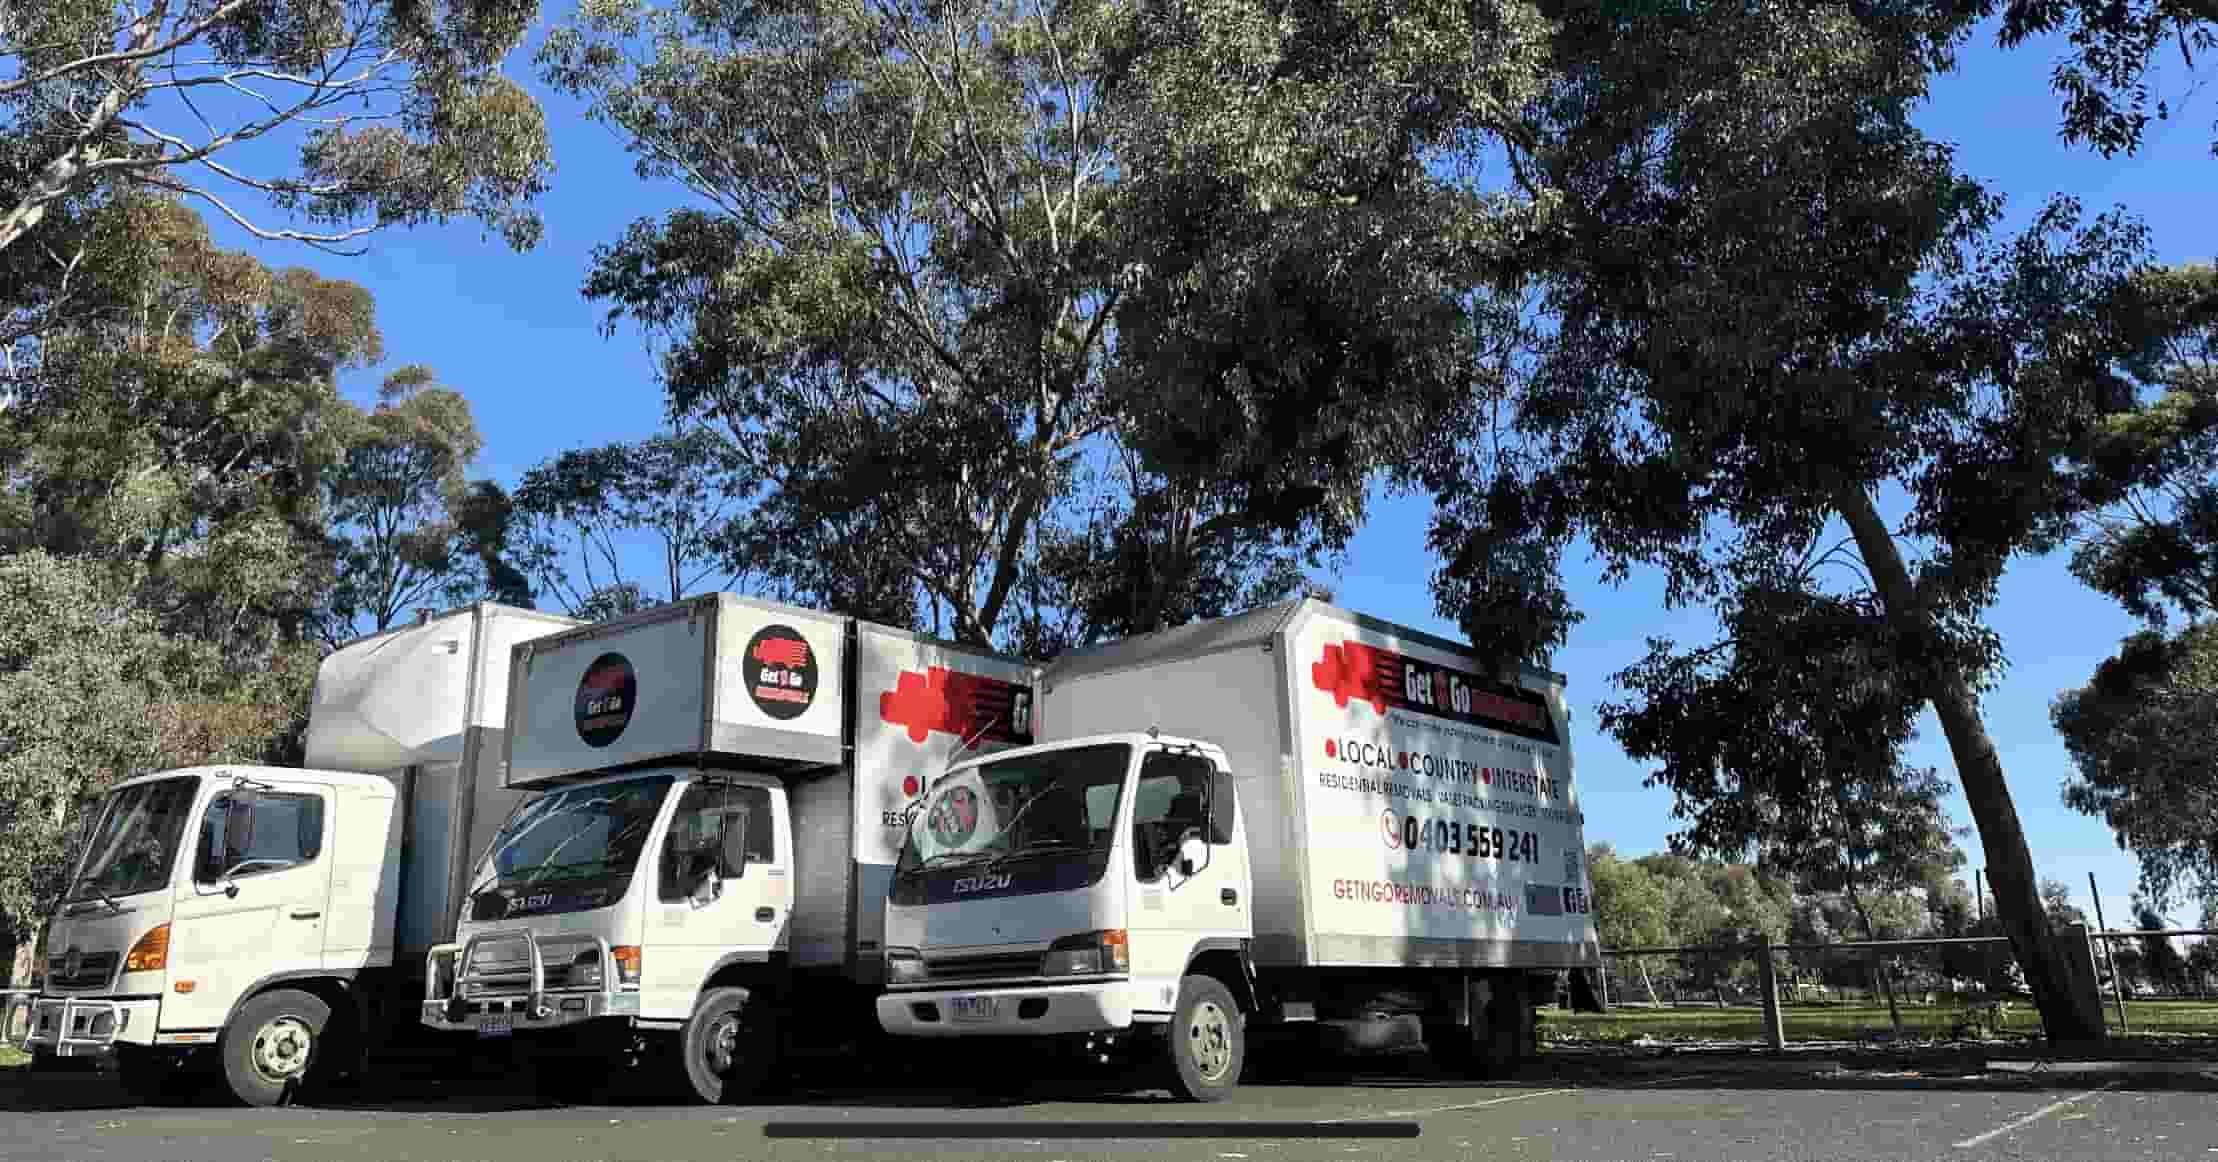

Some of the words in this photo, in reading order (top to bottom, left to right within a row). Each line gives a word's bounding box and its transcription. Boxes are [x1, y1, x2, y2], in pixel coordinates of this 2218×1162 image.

[1405, 664, 1433, 704] Get
[1450, 675, 1471, 713] Go
[1338, 737, 1395, 769] LOCAL
[1409, 752, 1478, 785] COUNTRY
[1490, 768, 1560, 800] INTERSTATE
[1404, 816, 1460, 853] 0403
[1466, 824, 1504, 858] 559
[1508, 830, 1538, 865] 241
[952, 874, 1015, 896] ISUZU
